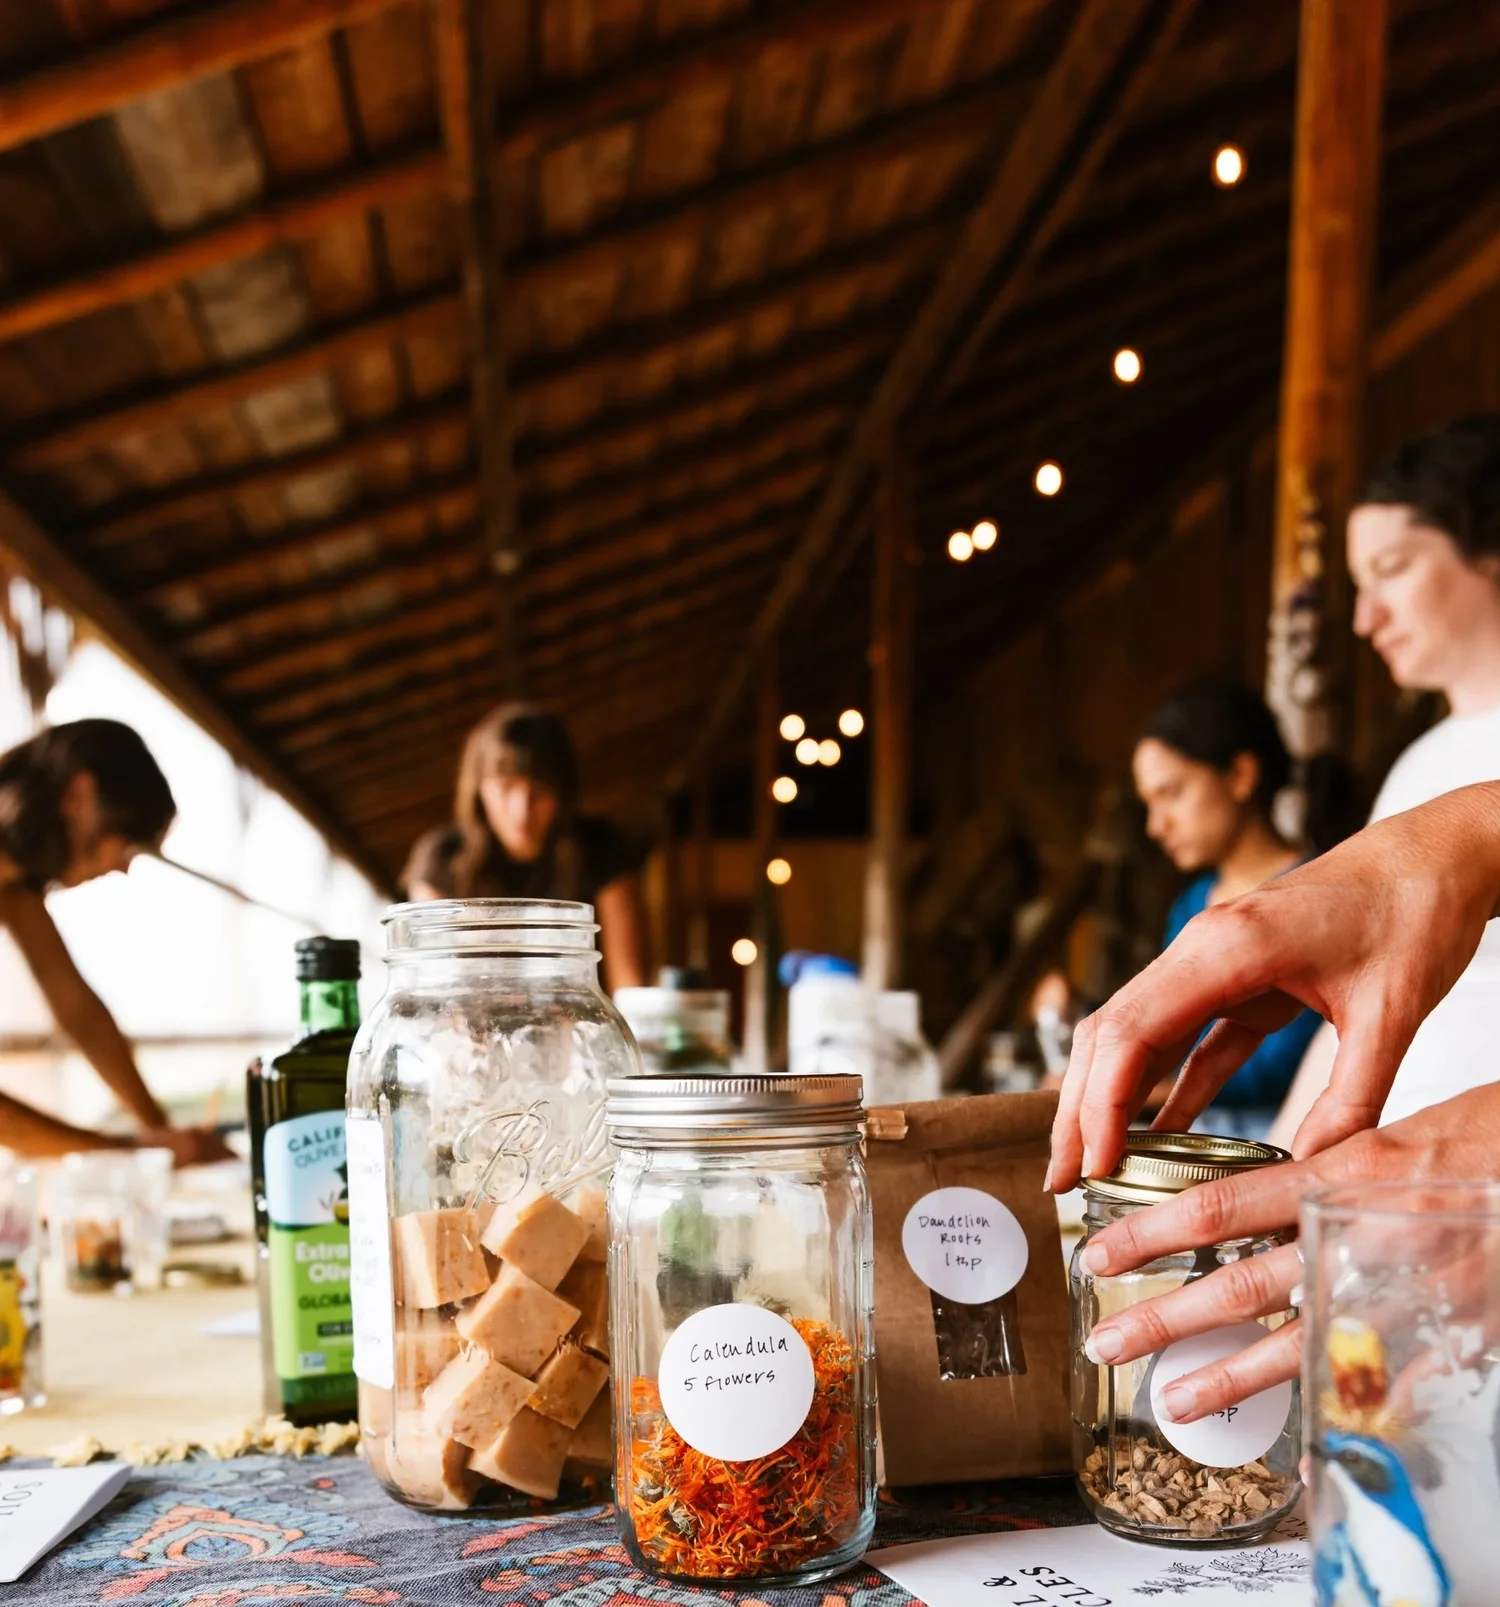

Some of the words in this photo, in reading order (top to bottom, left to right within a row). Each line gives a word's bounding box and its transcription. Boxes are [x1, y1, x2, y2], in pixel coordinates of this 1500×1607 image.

[918, 1215, 991, 1229] Dandelion
[940, 1232, 982, 1246] Roots
[294, 1240, 349, 1264] Extra
[956, 1255, 982, 1271] tsp
[690, 1336, 789, 1363] Calendula
[684, 1377, 697, 1391] 5
[705, 1370, 775, 1391] flowers
